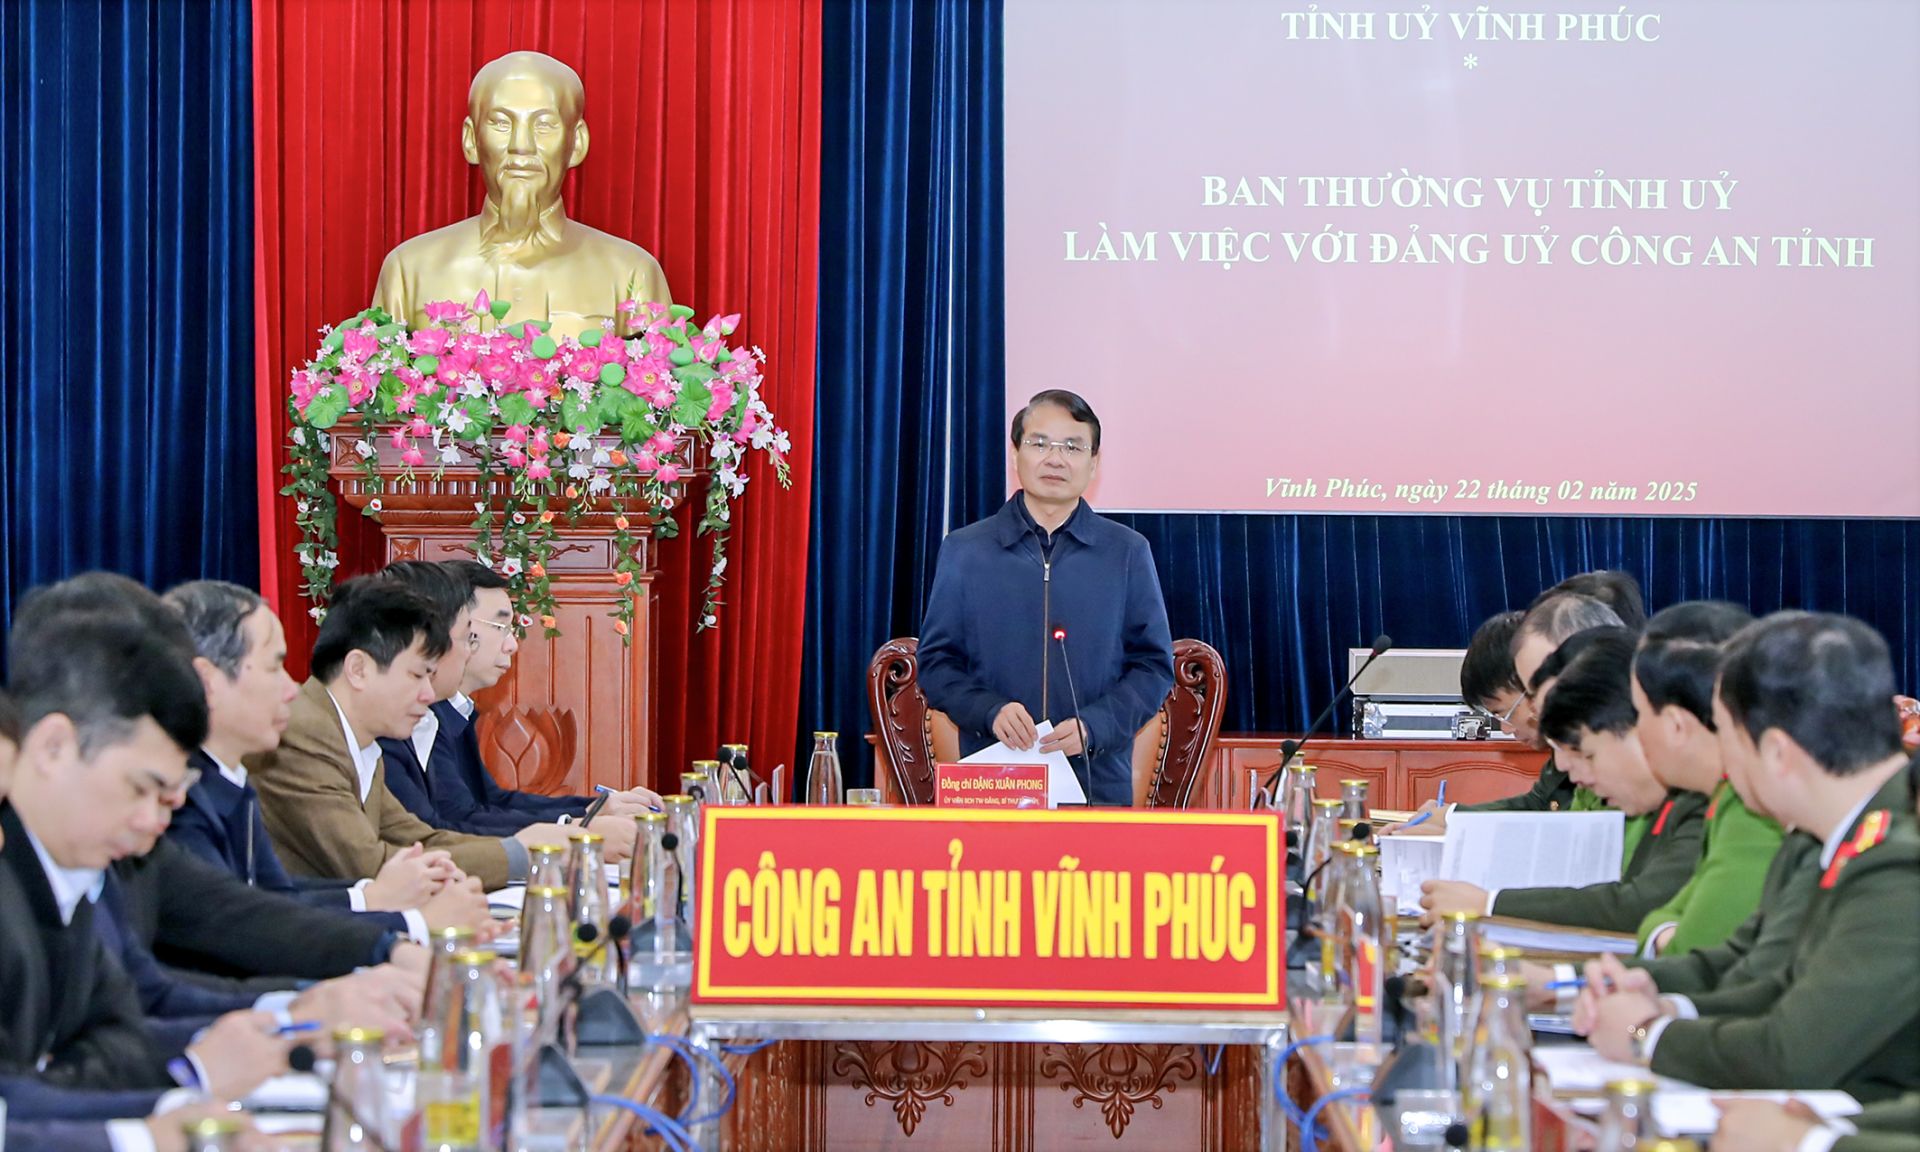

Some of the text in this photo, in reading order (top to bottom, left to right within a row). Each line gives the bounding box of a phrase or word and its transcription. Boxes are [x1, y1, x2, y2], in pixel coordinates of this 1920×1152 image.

[1281, 5, 1662, 42] TỈNH UỶ VĨNH PHÚC
[1203, 169, 1739, 218] BAN THƯỜNG VỤ TỈNH UỶ
[1064, 222, 1875, 271] LÀM VIỆC VỚI ĐẢNG UỶ CÔNG AN TỈNH
[1266, 478, 1699, 506] Vĩnh Phúc, ngày 22 tháng 02 năm 2025
[995, 776, 1016, 790] XUÂN
[1016, 779, 1044, 790] PHONG
[723, 838, 1257, 962] CÔNG AN TỈNH VĨNH PHÚC
